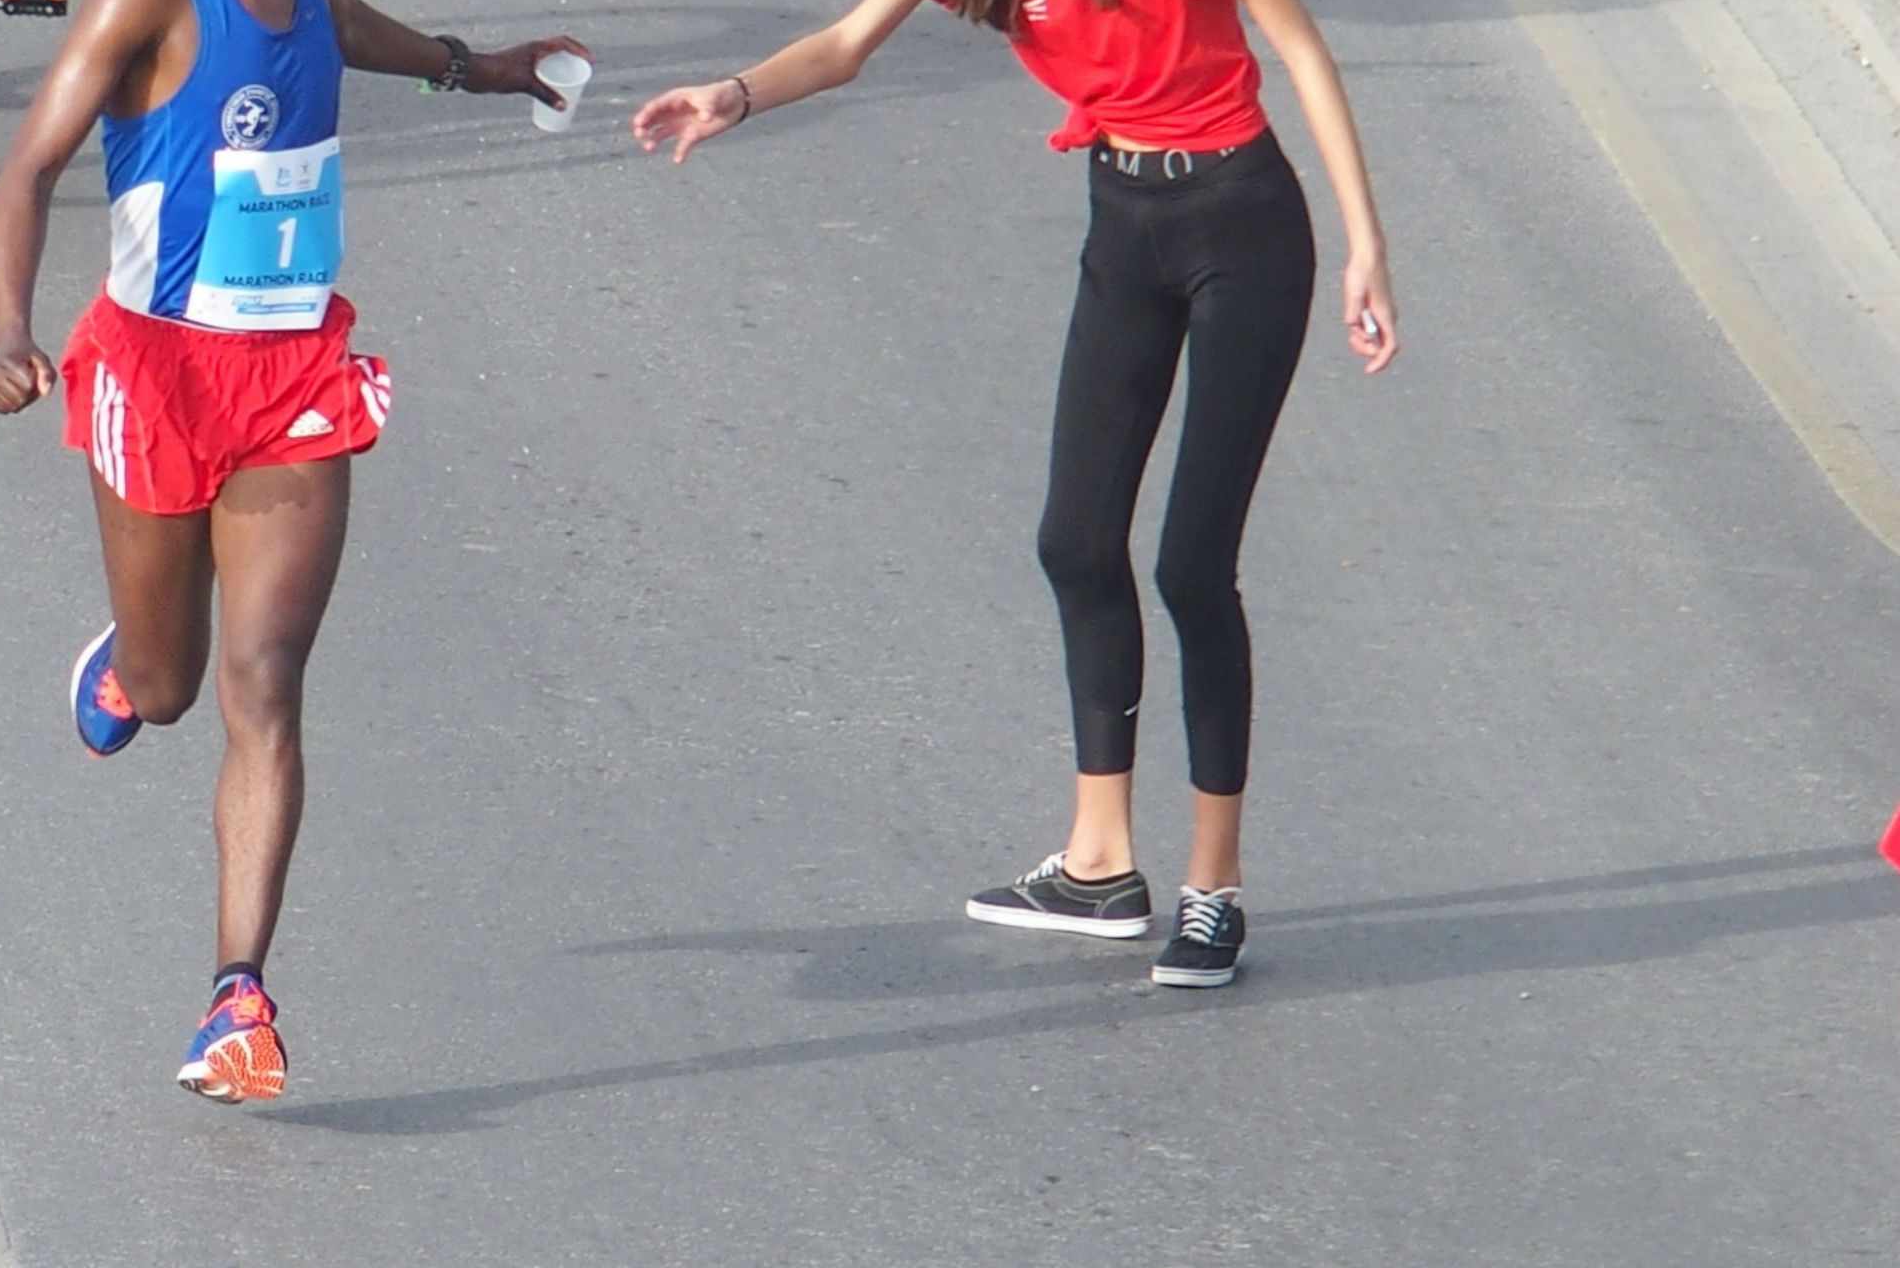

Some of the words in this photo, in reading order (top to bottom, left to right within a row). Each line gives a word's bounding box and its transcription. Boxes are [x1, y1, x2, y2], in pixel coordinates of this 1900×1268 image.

[238, 198, 307, 213] MARATHON
[277, 217, 297, 269] 1
[223, 273, 295, 287] MARATHON
